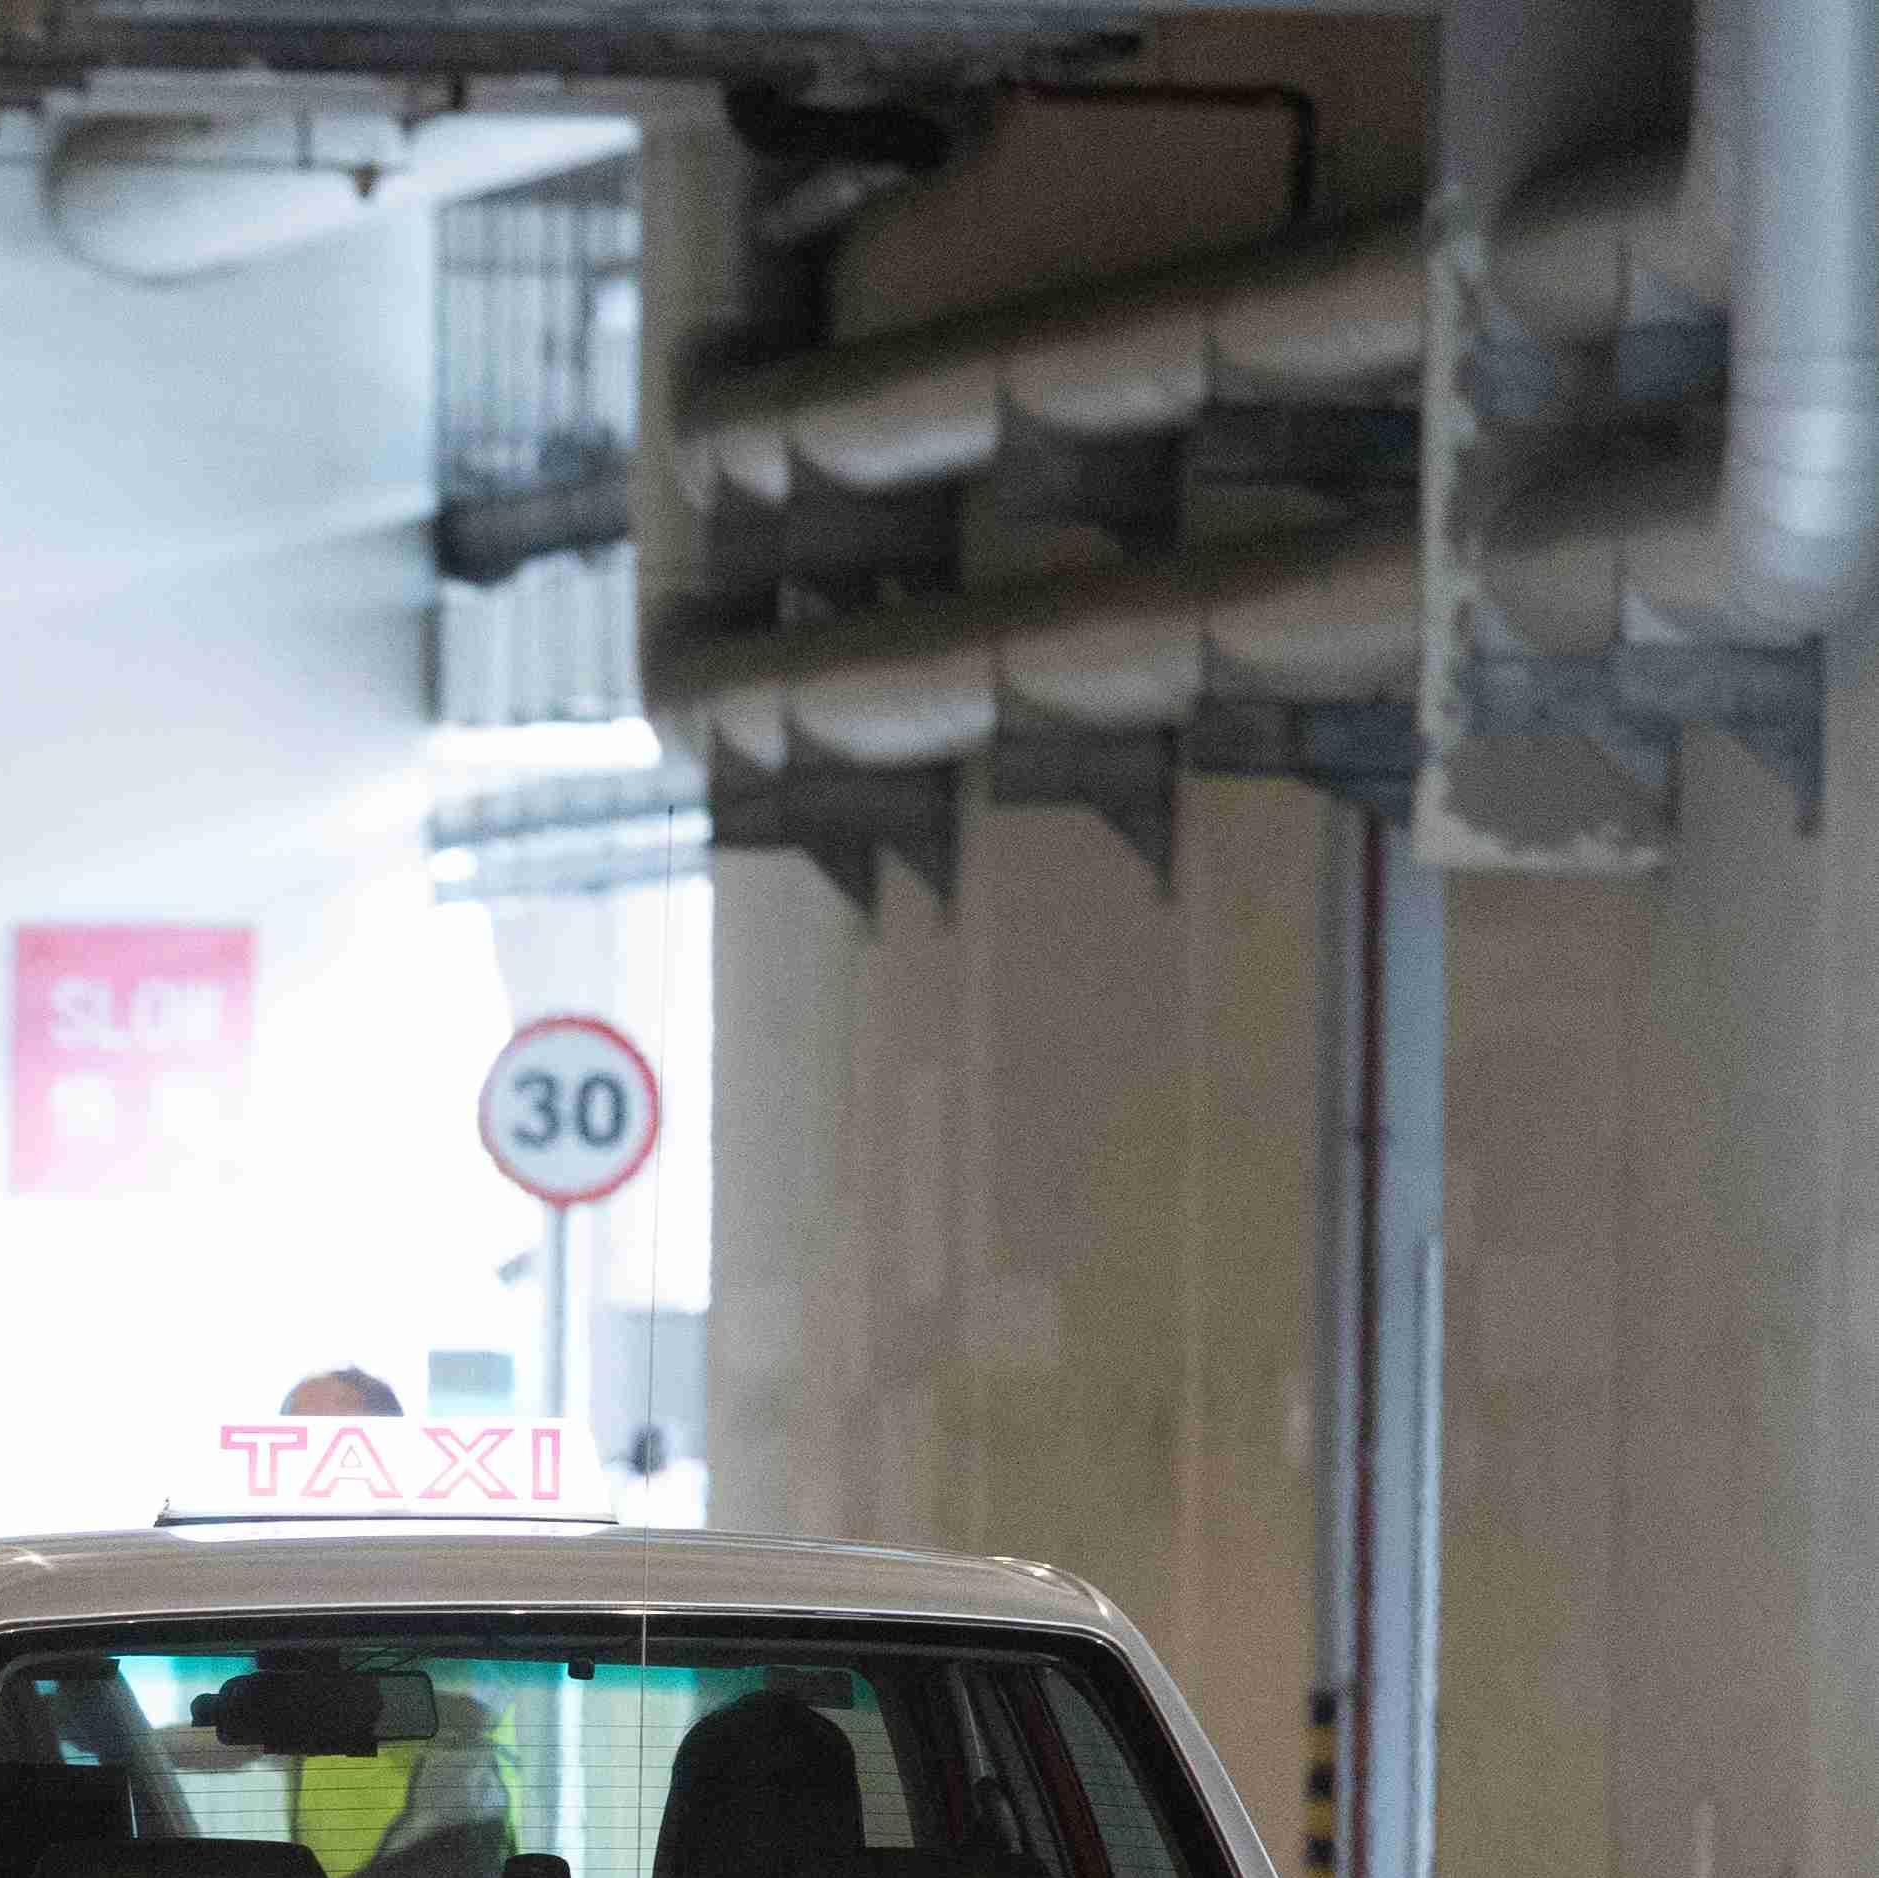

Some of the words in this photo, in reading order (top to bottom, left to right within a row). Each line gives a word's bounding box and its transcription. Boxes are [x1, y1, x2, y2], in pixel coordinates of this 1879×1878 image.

[50, 975, 223, 1050] SLO
[513, 1070, 627, 1148] 30
[220, 1425, 561, 1500] TAXI
